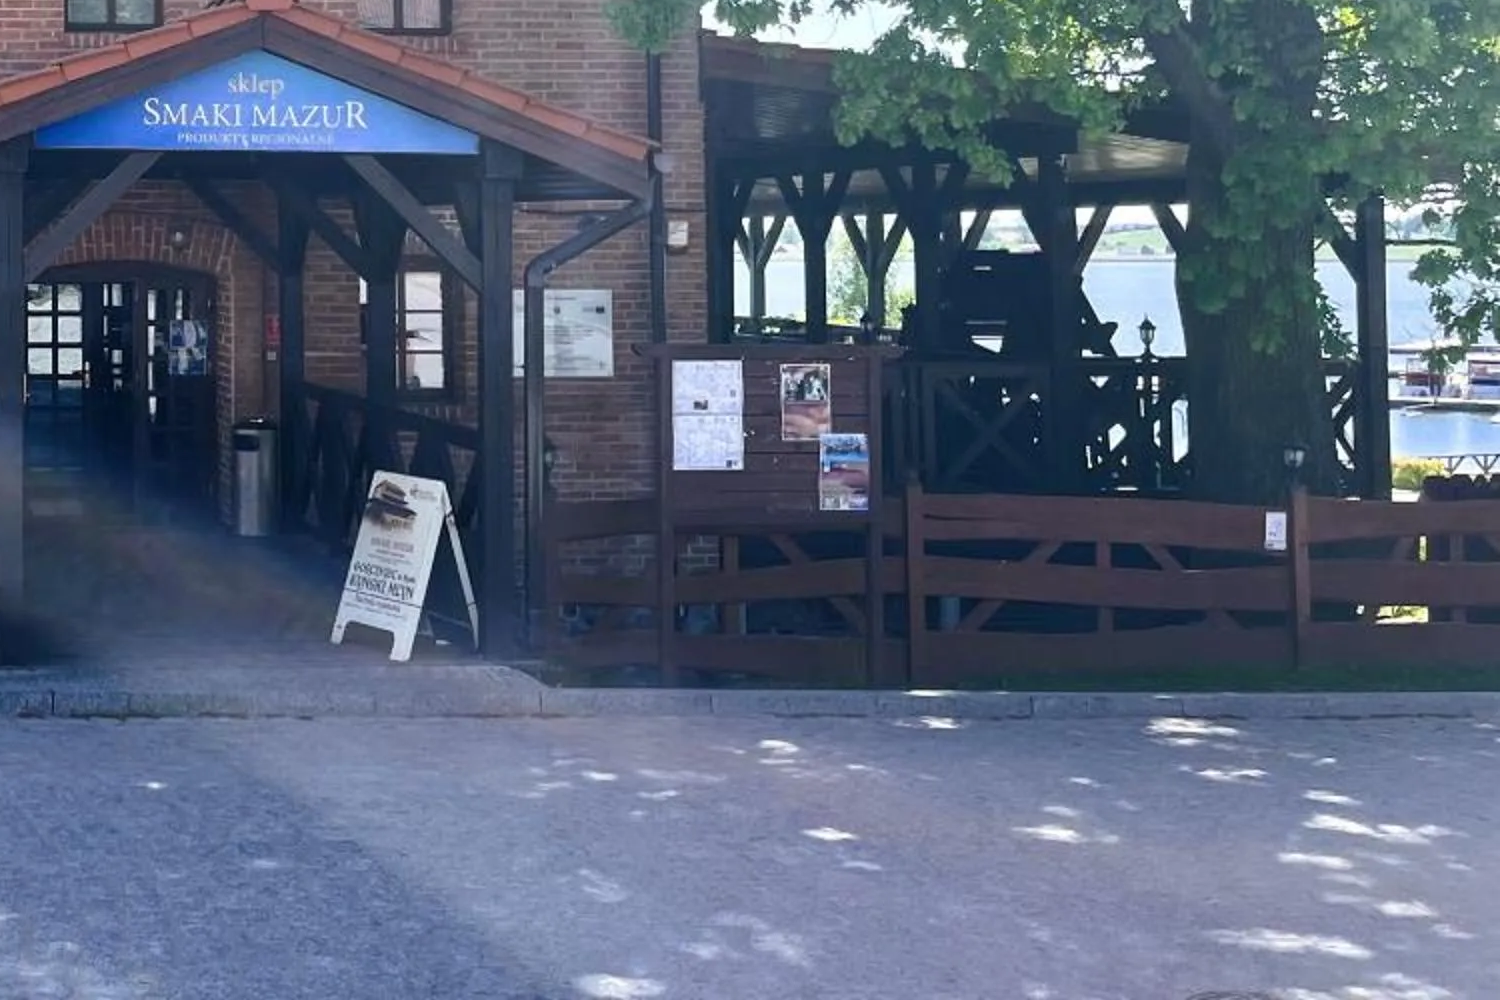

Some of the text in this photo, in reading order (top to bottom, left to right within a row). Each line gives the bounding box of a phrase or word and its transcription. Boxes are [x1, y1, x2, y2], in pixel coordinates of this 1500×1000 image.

[228, 71, 284, 99] sklep
[143, 97, 368, 129] SMAKI MAZUR
